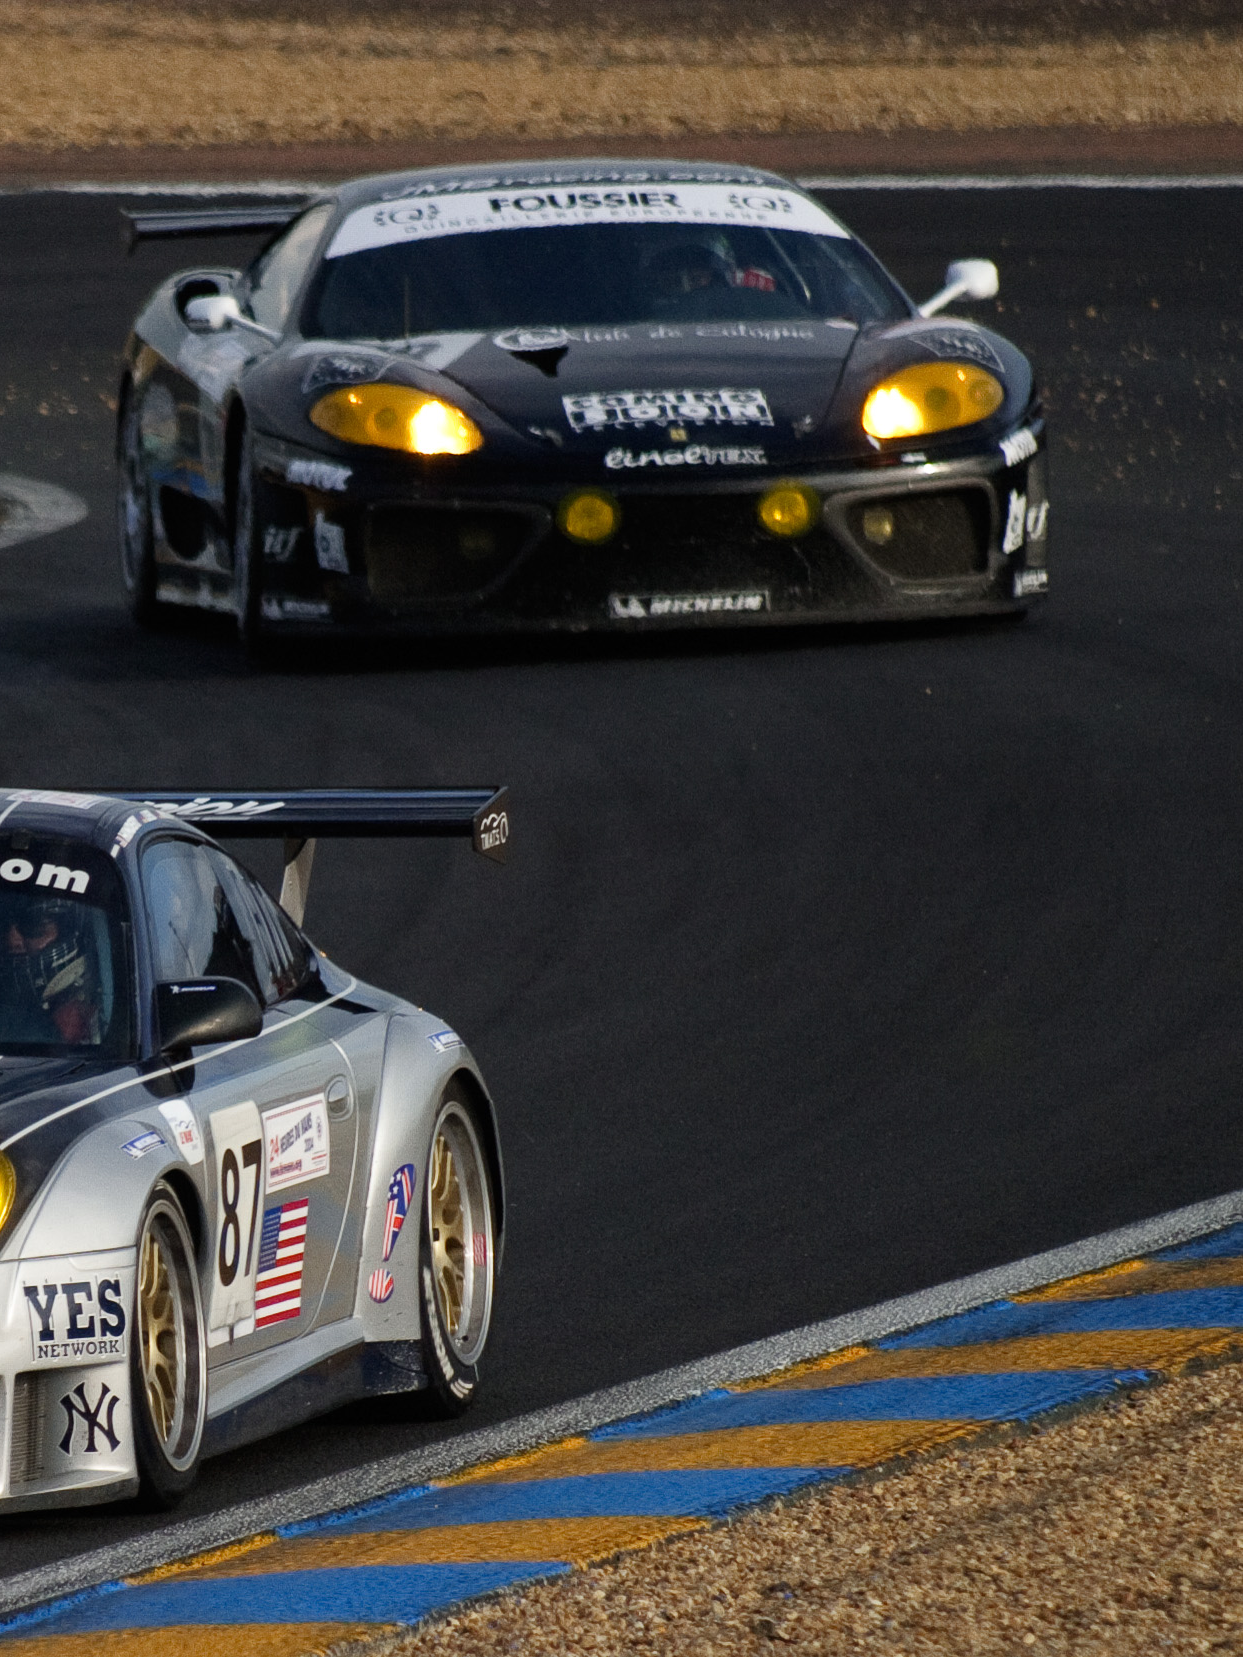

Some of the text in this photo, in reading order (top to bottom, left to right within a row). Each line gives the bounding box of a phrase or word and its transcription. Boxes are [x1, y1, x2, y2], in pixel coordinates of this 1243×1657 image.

[489, 192, 681, 214] FOUSSIER
[219, 1138, 262, 1287] 87
[23, 1278, 126, 1342] YES
[37, 1339, 120, 1359] NETWORK
